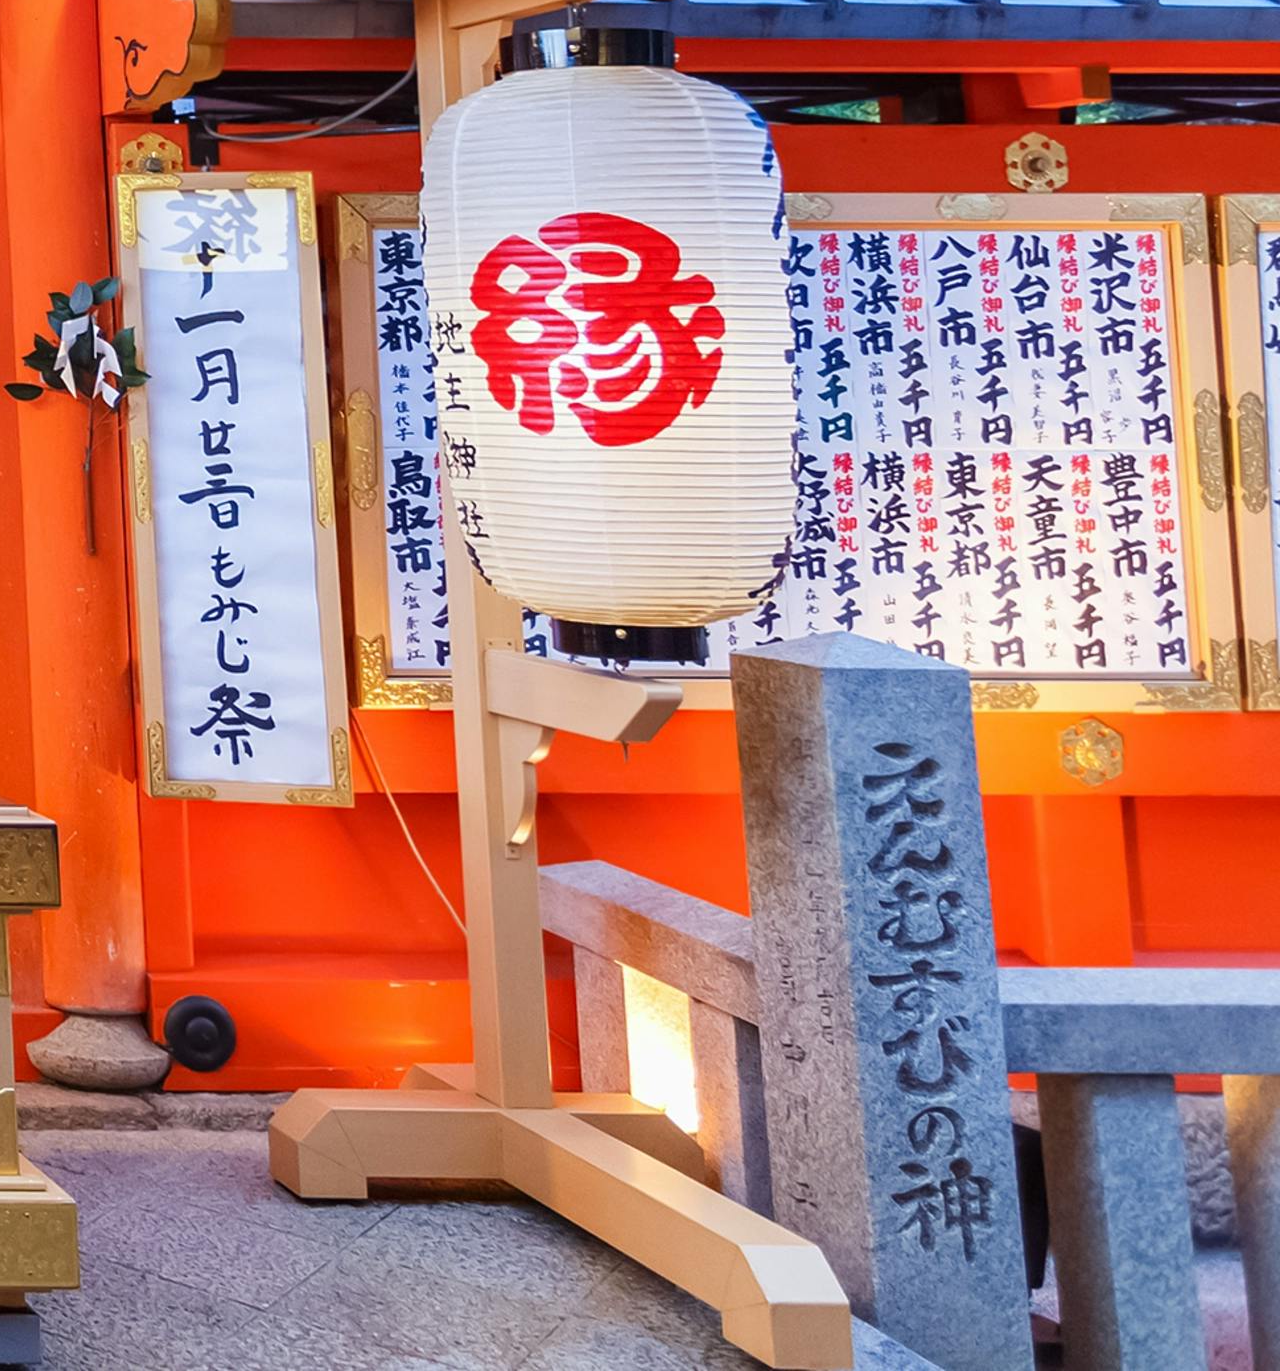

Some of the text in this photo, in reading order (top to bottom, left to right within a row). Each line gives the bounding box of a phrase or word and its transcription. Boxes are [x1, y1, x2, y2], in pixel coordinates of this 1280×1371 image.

[377, 231, 424, 353] 東京都
[847, 232, 900, 356] 横浜市
[898, 233, 934, 448] 縁結び御礼 五千円
[930, 236, 977, 348] 八戸市
[975, 233, 1014, 446] 縁結び御礼 五千円
[1006, 234, 1055, 360] 仙台市
[1056, 233, 1094, 445] 縁結び御礼 五千円
[1088, 232, 1137, 356] 米沢市
[1136, 234, 1173, 446] 縁結び御礼 五千円
[817, 337, 854, 443] 五千円
[386, 451, 436, 574] 鳥取市
[832, 453, 859, 553] 縁結び御礼
[860, 451, 911, 576] 横浜市
[912, 453, 939, 553] 縁結び御礼
[943, 452, 992, 579] 東京都
[989, 452, 1026, 667] 縁結び御礼 五千円
[1022, 454, 1068, 580] 天童市
[1070, 454, 1108, 669] 縁結び御礼 五千円
[1100, 452, 1149, 578] 豊中市
[1149, 453, 1188, 668] 縁結び御礼 五千円
[862, 743, 995, 1264] えんむすびの神
